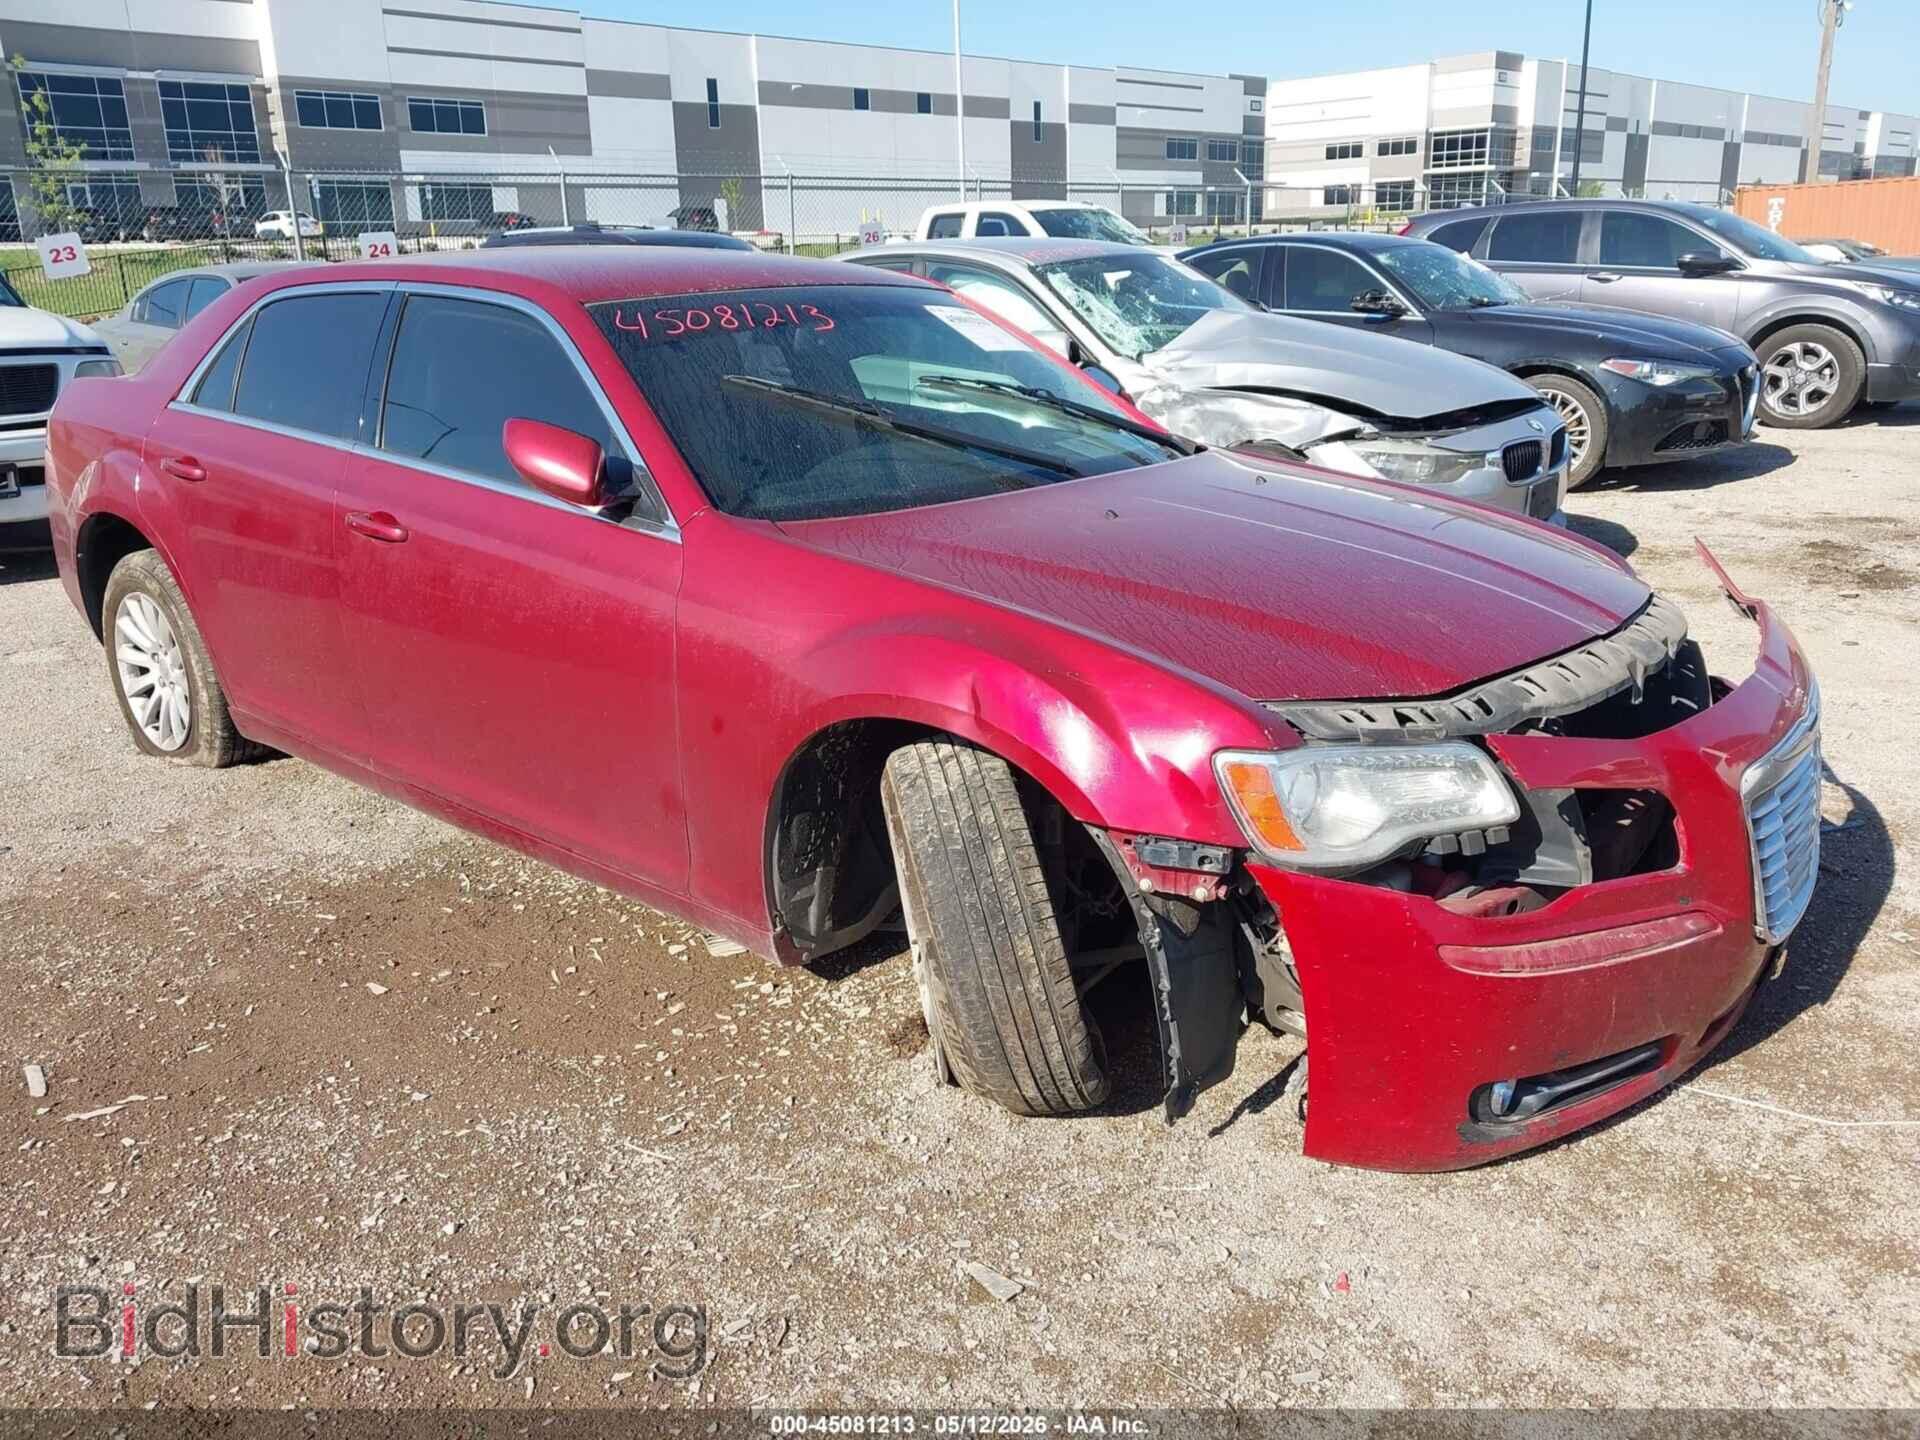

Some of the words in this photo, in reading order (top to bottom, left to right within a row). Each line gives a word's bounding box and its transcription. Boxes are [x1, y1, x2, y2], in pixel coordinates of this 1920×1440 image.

[864, 231, 880, 243] 26
[49, 246, 77, 263] 23
[369, 243, 390, 258] 24
[615, 303, 834, 339] 45081213
